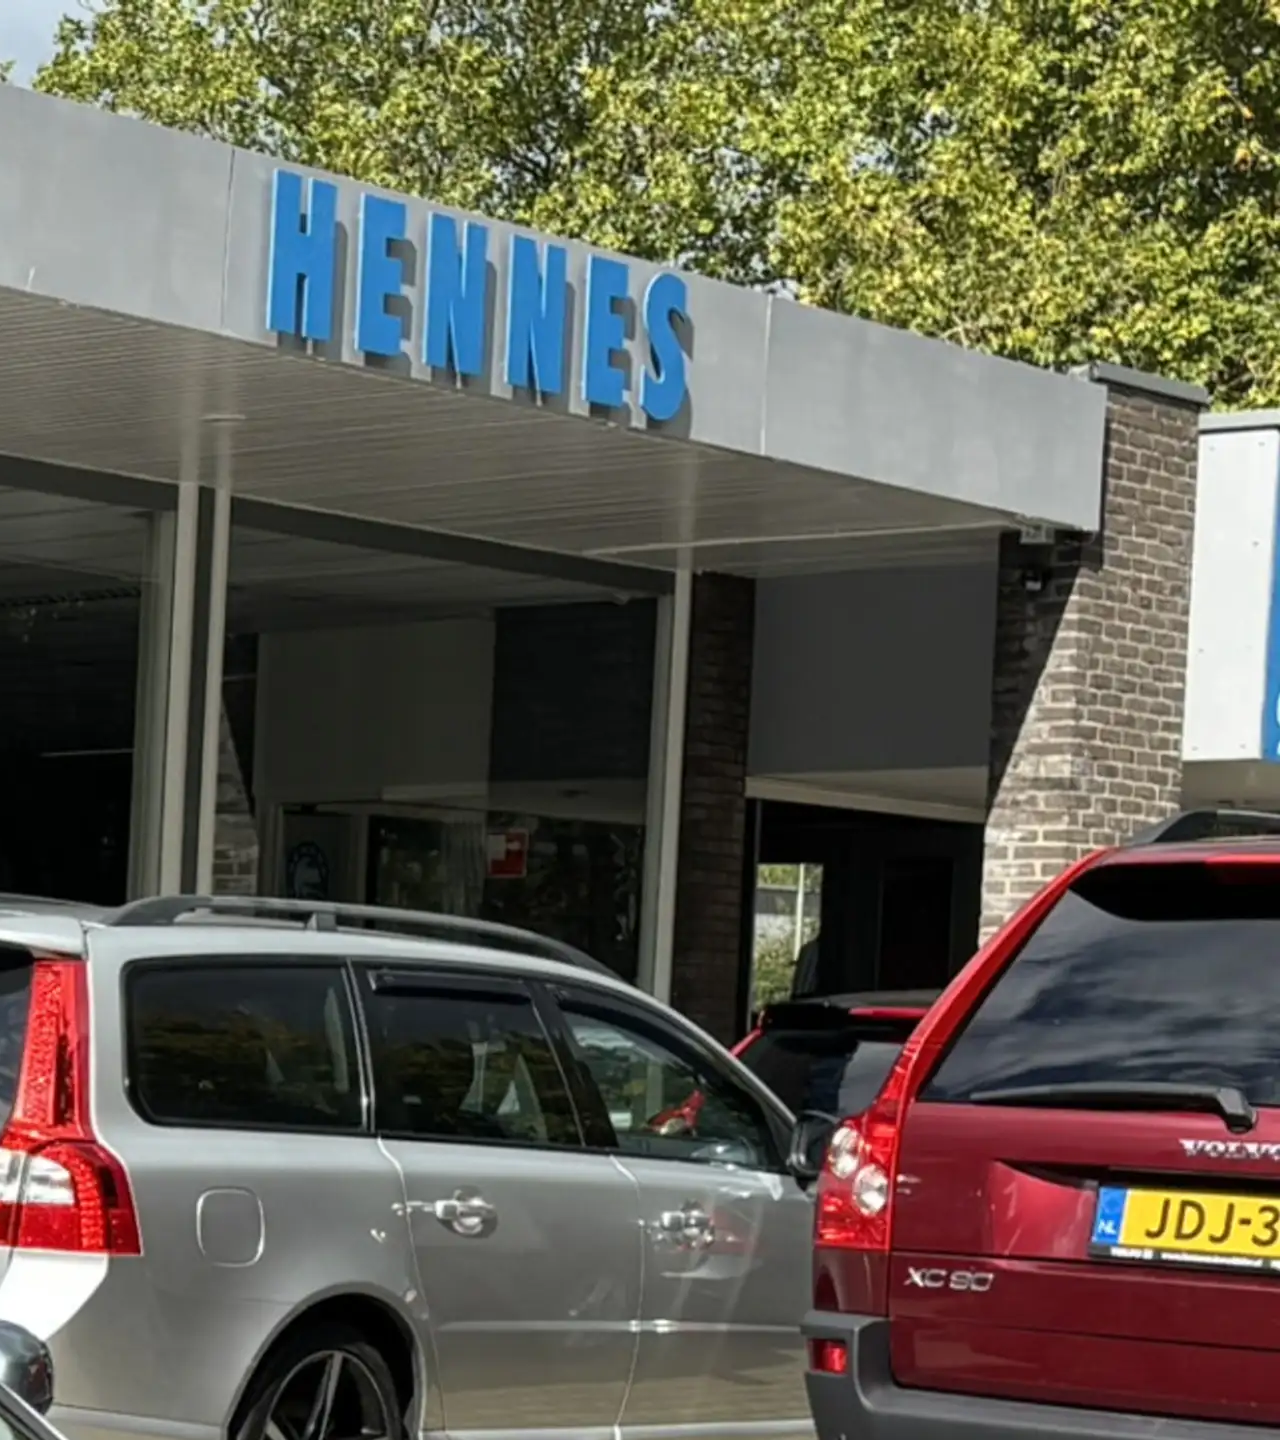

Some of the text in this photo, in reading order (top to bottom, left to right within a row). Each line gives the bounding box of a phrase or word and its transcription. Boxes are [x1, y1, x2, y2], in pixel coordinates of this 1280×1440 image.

[266, 168, 688, 420] HENNES
[1179, 1138, 1280, 1161] VOLVO
[1097, 1219, 1117, 1235] NL
[1144, 1197, 1280, 1247] JDJ-3
